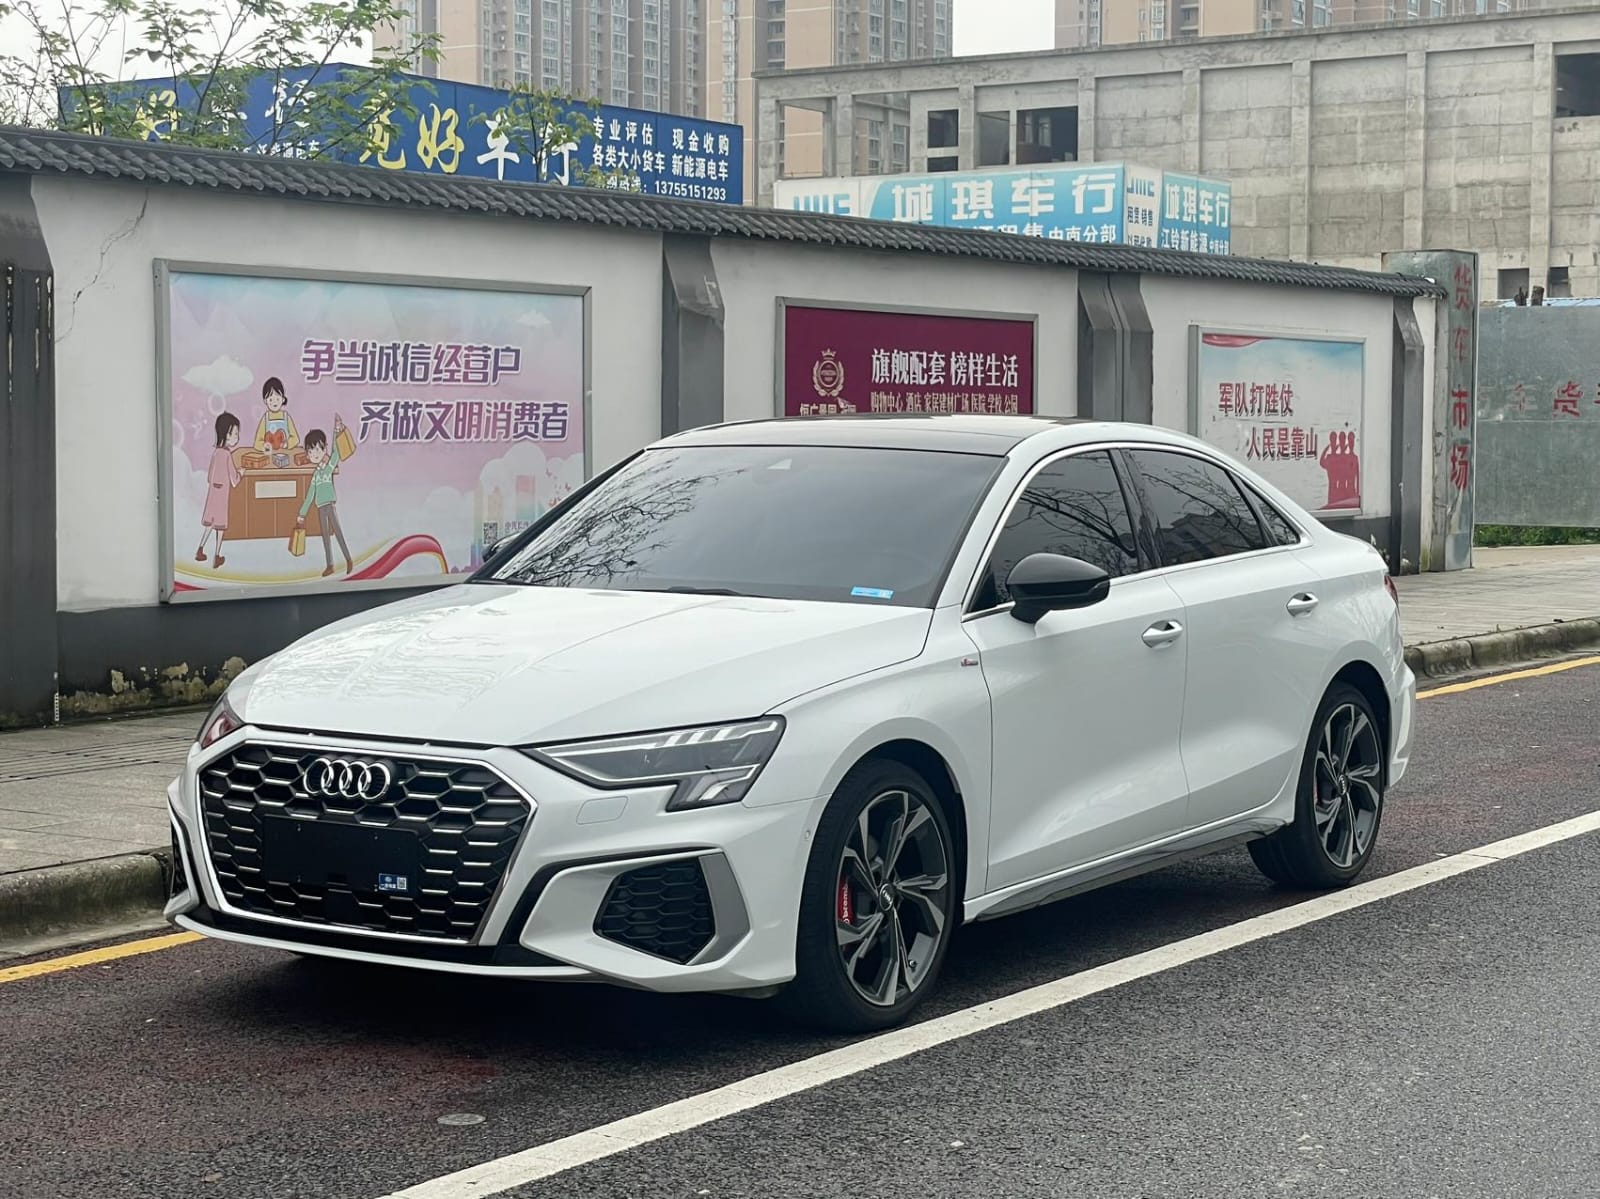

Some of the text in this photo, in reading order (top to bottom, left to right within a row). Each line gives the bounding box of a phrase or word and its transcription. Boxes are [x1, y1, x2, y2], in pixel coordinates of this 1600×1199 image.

[593, 115, 729, 156] 专业评估 现金收购
[592, 143, 729, 182] 各类大小货车 新能源电车
[301, 339, 523, 385] 争当诚信经营户
[871, 348, 1018, 388] 旗舰配套 榜样生活
[1218, 381, 1295, 416] 军队打胜仗
[358, 400, 570, 442] 齐做文明消费者
[1246, 427, 1319, 461] 人民是靠山
